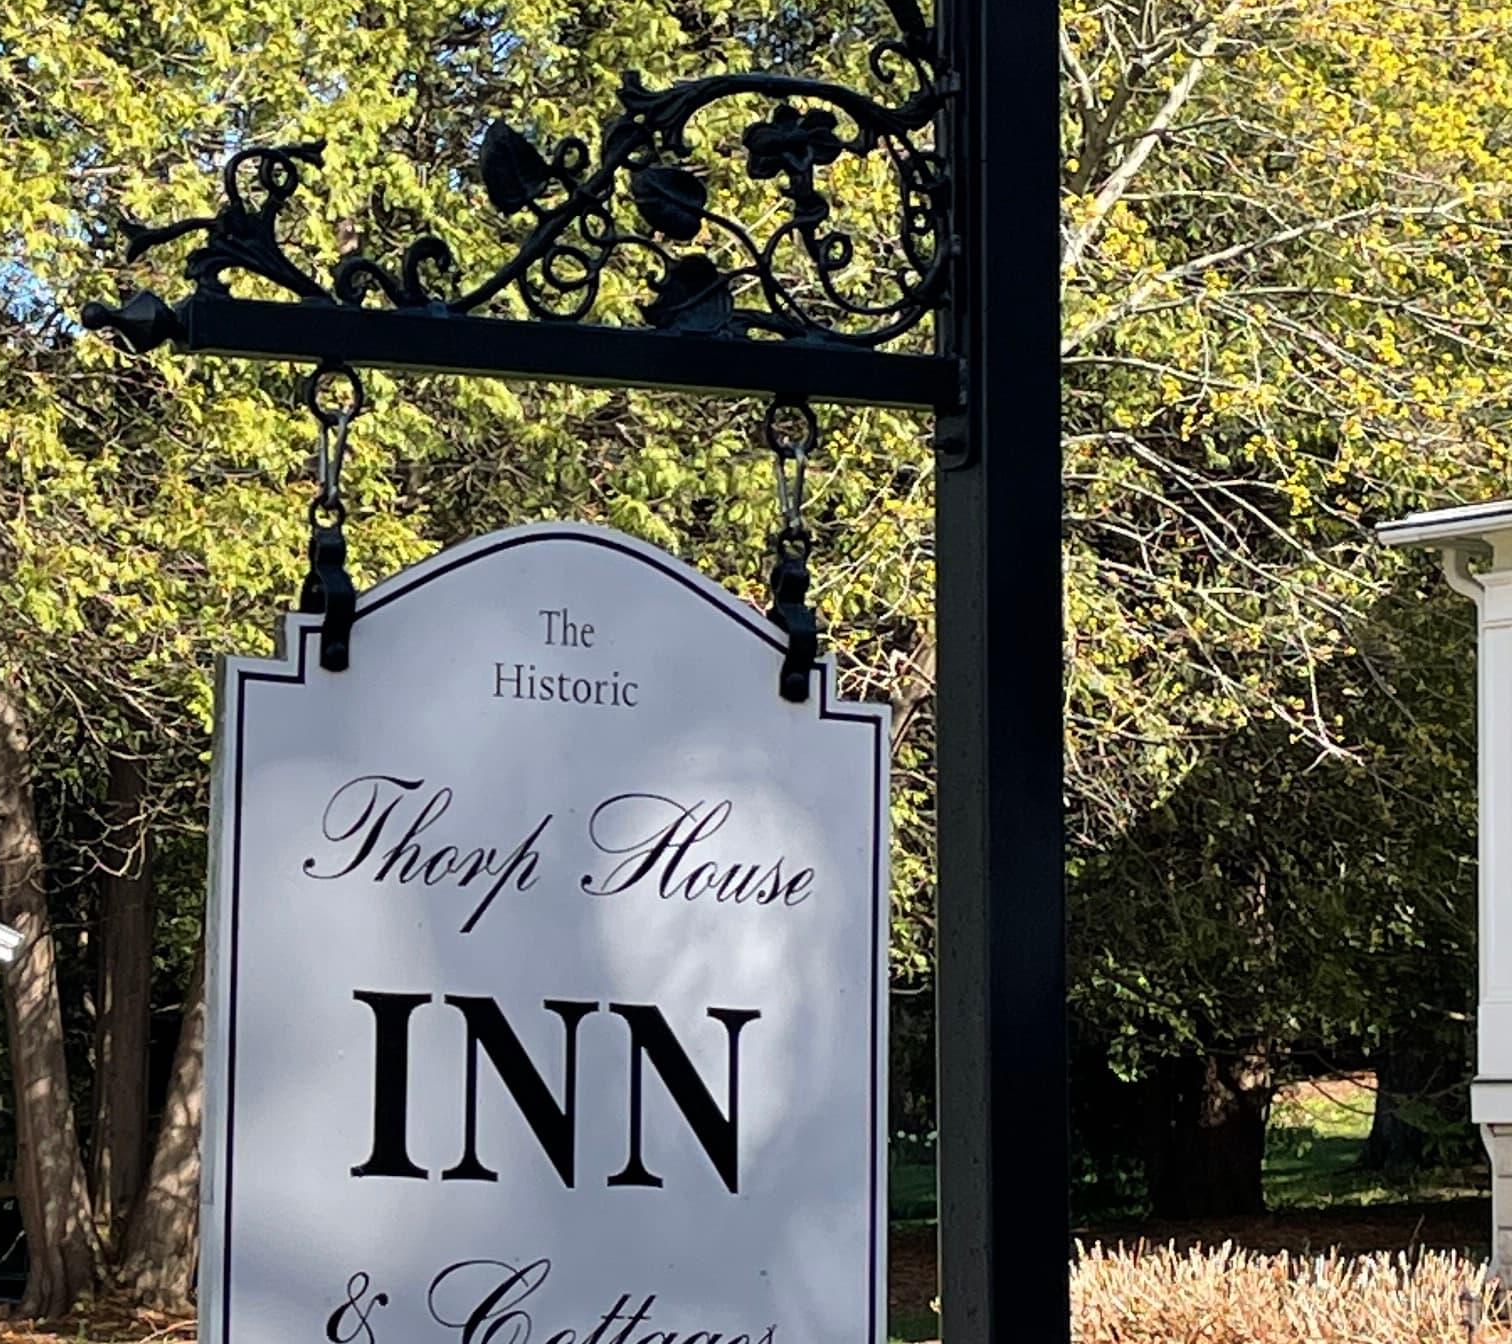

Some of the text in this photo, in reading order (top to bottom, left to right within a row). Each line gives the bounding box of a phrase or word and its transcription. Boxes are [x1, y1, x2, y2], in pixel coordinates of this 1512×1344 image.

[538, 607, 595, 648] The
[492, 661, 639, 708] Historic
[302, 774, 816, 935] Thorp House
[350, 989, 763, 1195] INN
